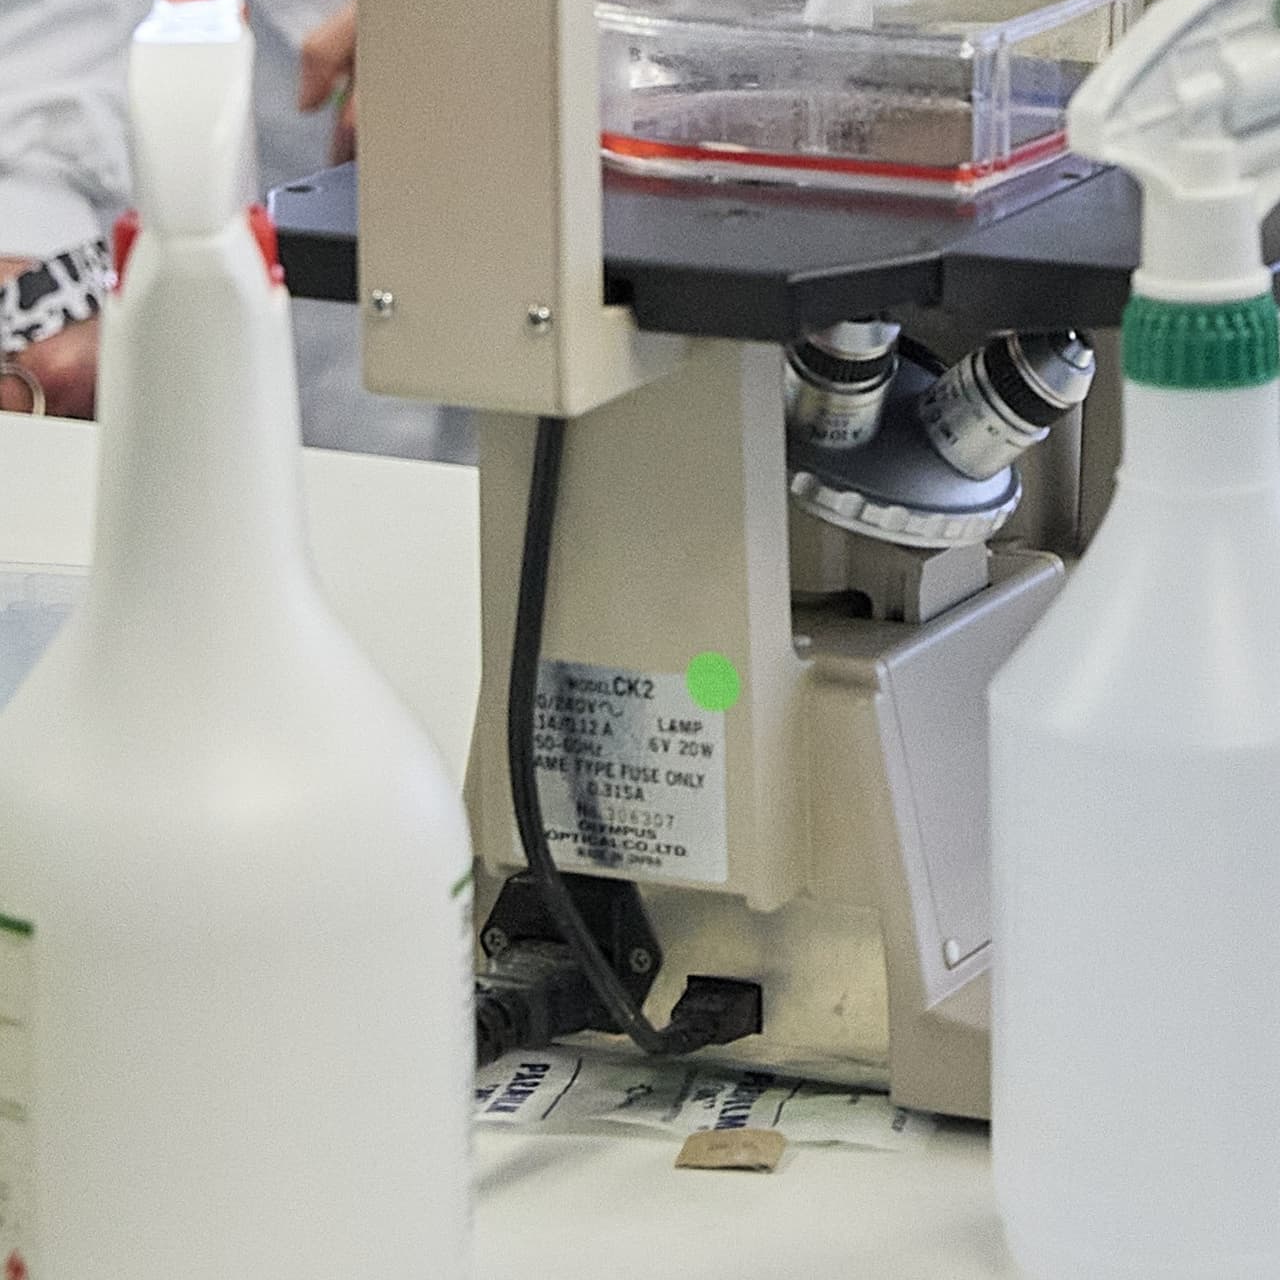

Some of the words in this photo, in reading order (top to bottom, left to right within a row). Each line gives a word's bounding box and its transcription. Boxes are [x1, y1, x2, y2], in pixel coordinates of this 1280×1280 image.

[612, 675, 655, 700] CK2
[656, 716, 703, 734] LAMP
[534, 753, 567, 773] AME
[574, 757, 615, 779] TYPE
[619, 763, 660, 785] FUSE
[665, 769, 705, 789] ONLY
[577, 818, 658, 840] OLYMPUS
